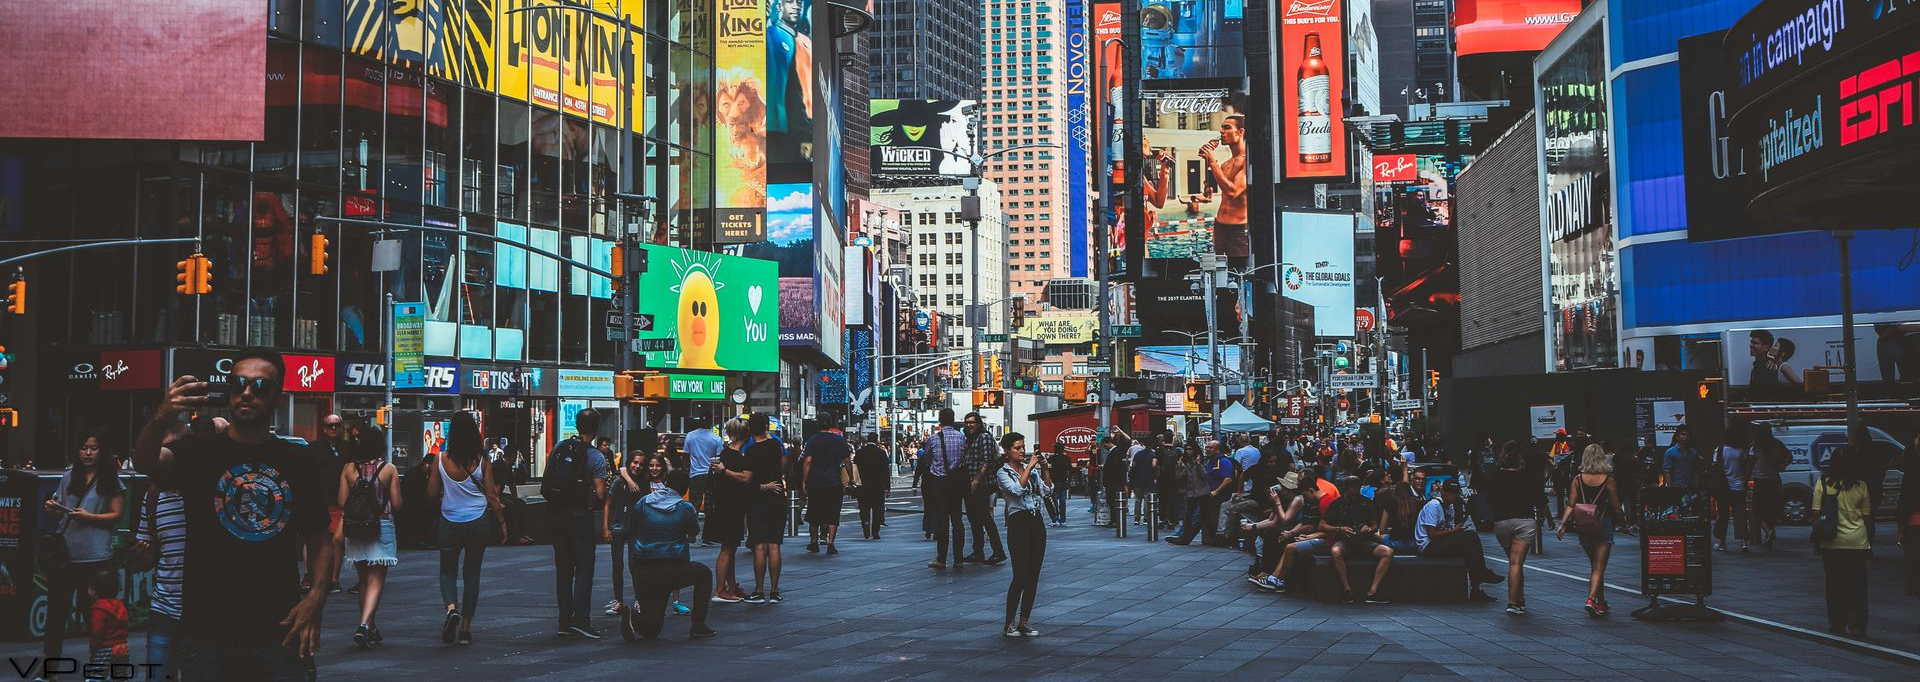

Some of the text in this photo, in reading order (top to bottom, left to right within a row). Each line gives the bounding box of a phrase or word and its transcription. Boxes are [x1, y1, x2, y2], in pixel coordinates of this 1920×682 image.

[1291, 3, 1331, 12] Budweiser
[508, 0, 571, 68] LION
[720, 12, 763, 37] KING
[1069, 1, 1085, 95] NOVOTEL
[1752, 33, 1764, 80] in
[1767, 0, 1845, 69] campaign
[533, 87, 560, 104] ENTRANCE
[564, 98, 574, 108] ON
[575, 100, 588, 112] 45TH
[1840, 50, 1920, 147] ESPN
[1375, 157, 1414, 178] Ray-Ban
[1548, 171, 1593, 243] OLD NAVY
[1305, 272, 1351, 281] THE GLOBAL GOALS
[744, 315, 767, 343] YOU
[1038, 320, 1057, 328] WHAT
[1112, 326, 1120, 335] W
[1121, 326, 1132, 335] 44
[643, 342, 652, 350] W
[654, 341, 665, 350] 44
[1825, 349, 1844, 367] GA
[102, 359, 130, 380] Ray-Ban
[210, 375, 228, 383] OAK
[297, 359, 325, 388] Ray-Ban
[673, 380, 688, 393] NEW
[688, 381, 705, 394] YORK
[1291, 397, 1302, 417] tkts
